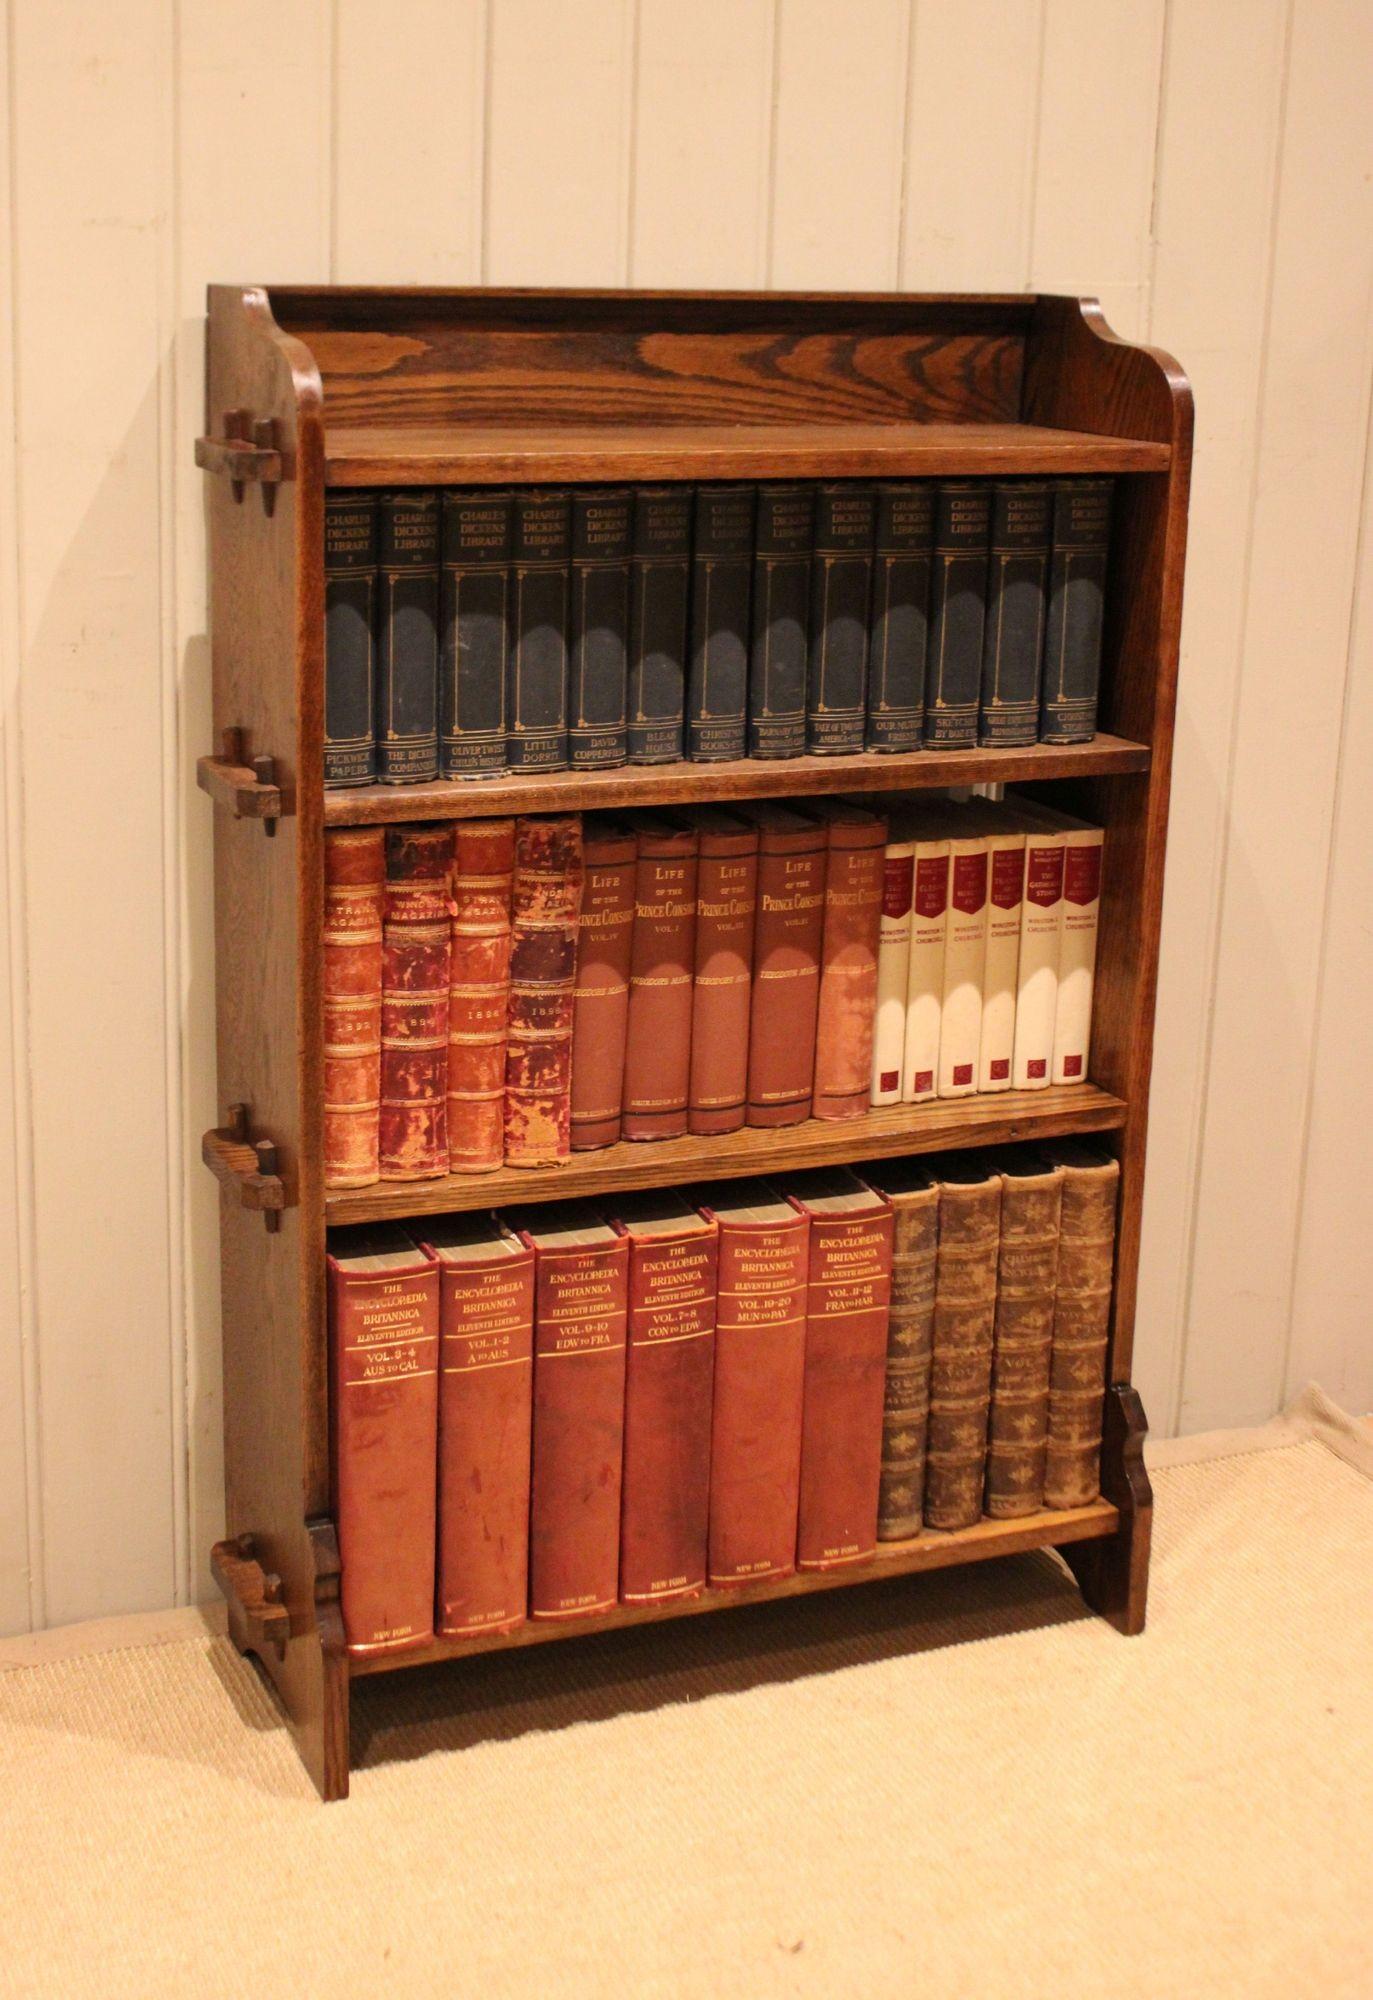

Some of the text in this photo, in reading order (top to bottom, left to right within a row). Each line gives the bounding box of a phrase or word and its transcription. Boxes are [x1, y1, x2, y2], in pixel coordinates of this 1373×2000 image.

[460, 511, 506, 521] CHARLES
[461, 523, 506, 533] DICKENS
[461, 536, 504, 547] LIBRARY
[525, 740, 559, 751] LITTLE
[590, 737, 617, 748] DAVID
[523, 751, 559, 762] DORRIT
[330, 765, 368, 776] PAPERS
[656, 867, 684, 880] LIFE
[720, 866, 746, 879] LIFE
[785, 861, 811, 873] LIFE
[592, 875, 620, 888] LIFE
[697, 899, 755, 917] PRINCE CONS
[762, 893, 823, 911] PRINCE CONS
[666, 901, 695, 917] CONS
[579, 909, 633, 926] INCE CONS
[846, 1226, 863, 1235] THE
[762, 1237, 781, 1246] THE
[669, 1247, 686, 1257] THE
[826, 1248, 878, 1263] BRITANNICA
[578, 1260, 595, 1268] THE
[741, 1261, 795, 1274] BRITANNICA
[483, 1274, 501, 1283] THE
[650, 1270, 702, 1287] BRITANNICA
[821, 1265, 882, 1279] ELEVENTH EDITION
[383, 1284, 402, 1293] THE
[558, 1283, 611, 1298] BRITANNICA
[734, 1278, 797, 1291] ELEVENTH EDITION
[644, 1288, 705, 1304] ELEVENTH EDITION
[463, 1297, 517, 1313] BRITANNICA
[552, 1302, 616, 1317] ELEVENTH EDITION
[826, 1300, 845, 1311] FRA
[855, 1295, 873, 1307] HAR
[363, 1308, 420, 1325] BRITANNICA
[678, 1309, 697, 1320] 7-8
[737, 1312, 760, 1322] MUN
[771, 1309, 789, 1319] PAY
[457, 1315, 521, 1333] ELEVENTH EDITION
[648, 1326, 669, 1337] CON
[680, 1320, 701, 1333] EDW
[357, 1326, 423, 1343] ELEVENTH EDITION
[556, 1338, 579, 1349] EDW
[591, 1334, 610, 1345] FRA
[468, 1354, 476, 1364] A
[488, 1349, 509, 1359] AUS
[363, 1365, 385, 1377] AUS
[399, 1359, 419, 1372] CAL
[823, 1548, 840, 1557] NEW
[736, 1565, 752, 1573] NEW
[650, 1580, 668, 1590] NEW
[560, 1598, 578, 1608] NEW
[468, 1614, 485, 1624] NEW
[373, 1630, 391, 1640] NEW
